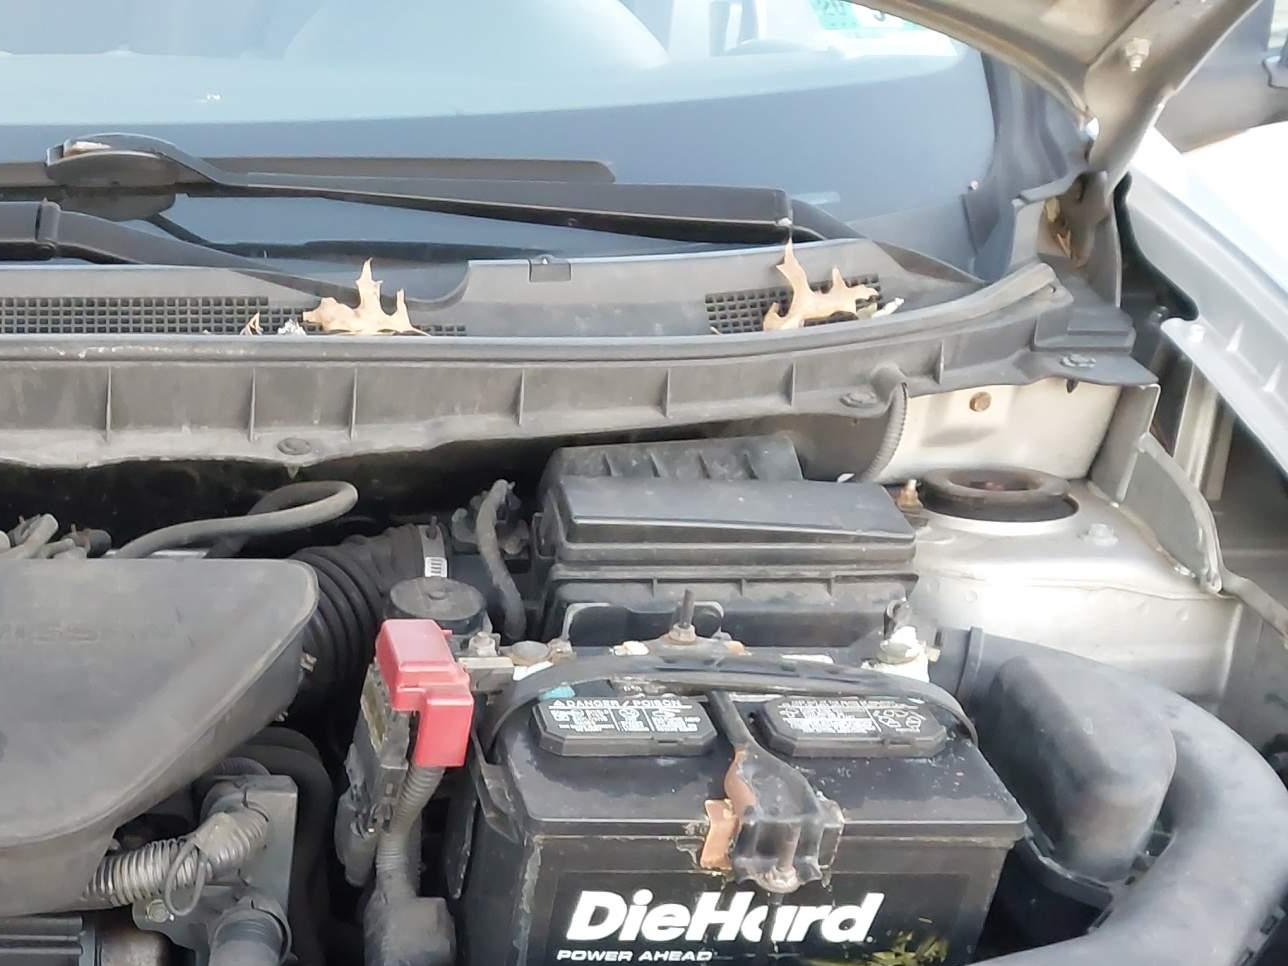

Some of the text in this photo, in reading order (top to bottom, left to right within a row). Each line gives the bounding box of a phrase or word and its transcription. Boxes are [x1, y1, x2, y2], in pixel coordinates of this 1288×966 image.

[566, 888, 885, 943] DieHard
[556, 950, 713, 962] POWER AHEAD
